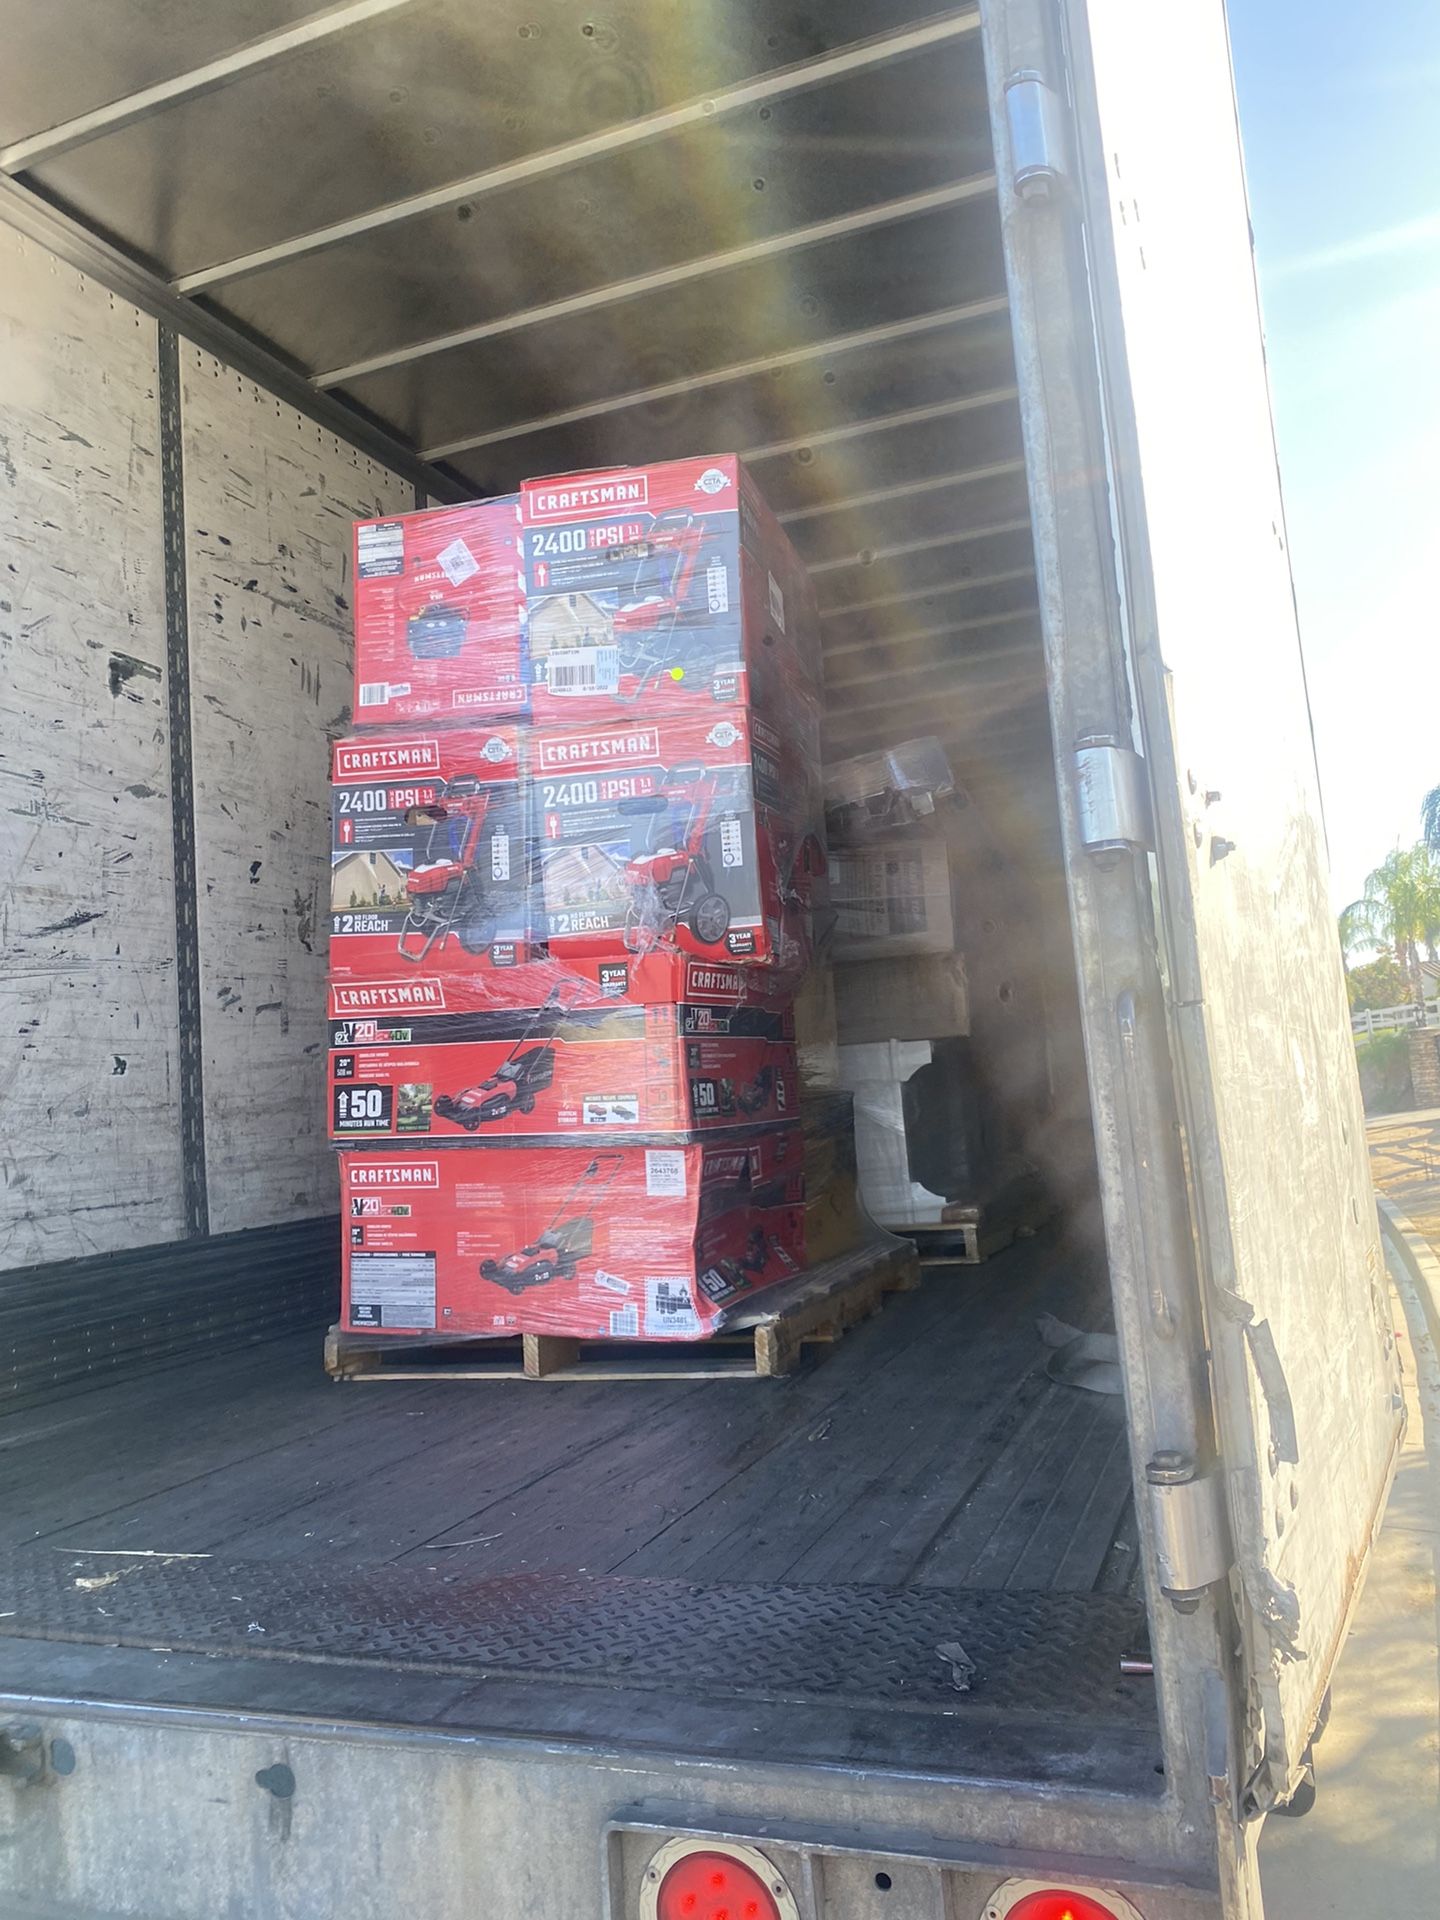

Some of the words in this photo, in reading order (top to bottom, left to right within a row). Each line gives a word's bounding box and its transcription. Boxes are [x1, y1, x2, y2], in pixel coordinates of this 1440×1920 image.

[537, 484, 640, 510] CRAFTSMAN
[532, 529, 586, 556] 2400
[596, 525, 624, 546] PSI
[713, 680, 720, 690] 3
[547, 735, 650, 761] CRAFTSMAN
[343, 748, 432, 769] CRAFTSMAN
[339, 789, 387, 813] 2400
[395, 789, 419, 808] PSI
[543, 780, 598, 808] 2400
[608, 778, 636, 799] PSI
[342, 914, 353, 932] 2
[354, 919, 388, 932] REACH
[557, 914, 570, 933] 2
[571, 915, 609, 931] REACH
[729, 933, 736, 944] 3
[737, 932, 751, 940] YEAR
[493, 945, 499, 955] 3
[601, 970, 609, 982] 3
[610, 969, 626, 977] YEAR
[692, 971, 739, 990] CRAFTSMA
[341, 986, 435, 1006] CRAFTSMAN
[351, 1089, 382, 1118] 50
[699, 1083, 715, 1106] 50
[351, 1168, 432, 1183] CRAFTSMAN
